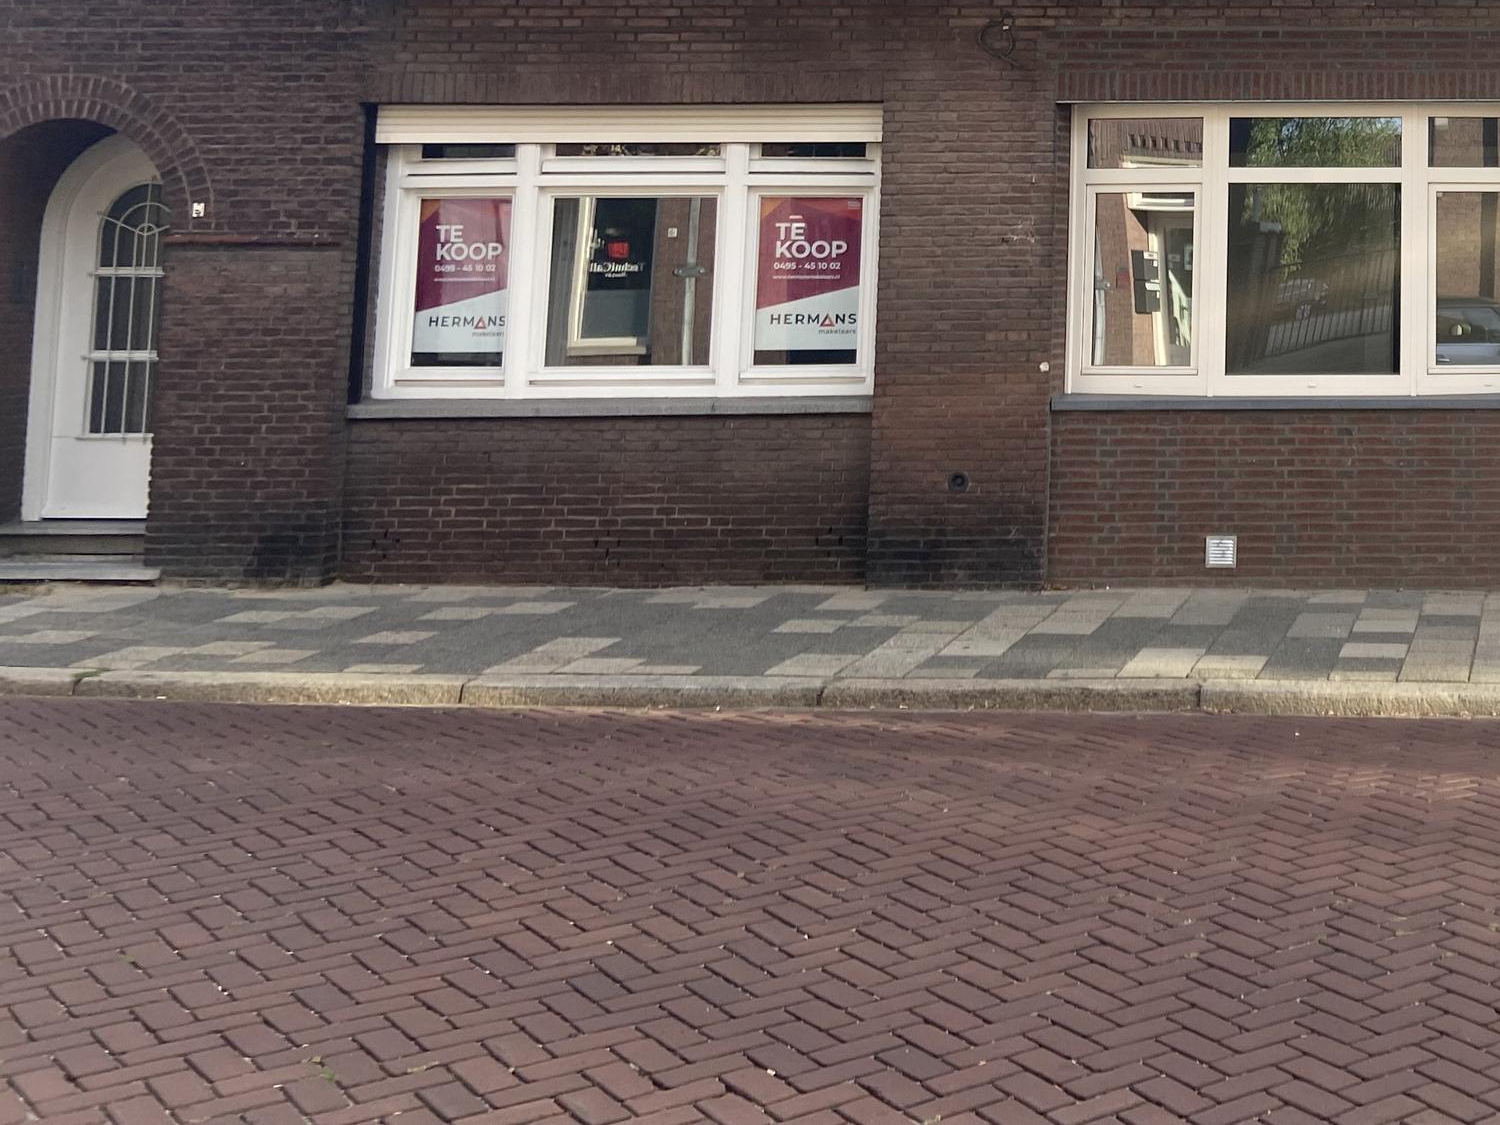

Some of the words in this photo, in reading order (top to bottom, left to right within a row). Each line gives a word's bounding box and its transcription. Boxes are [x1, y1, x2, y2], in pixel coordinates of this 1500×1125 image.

[436, 225, 464, 243] TE
[775, 222, 806, 240] TE
[436, 242, 503, 261] KOOP
[775, 240, 848, 259] KOOP
[773, 262, 797, 270] 0495
[804, 262, 816, 270] 45
[818, 262, 827, 270] 10
[829, 262, 841, 270] 02
[429, 315, 506, 330] HERMANS
[770, 313, 857, 328] HERMANS
